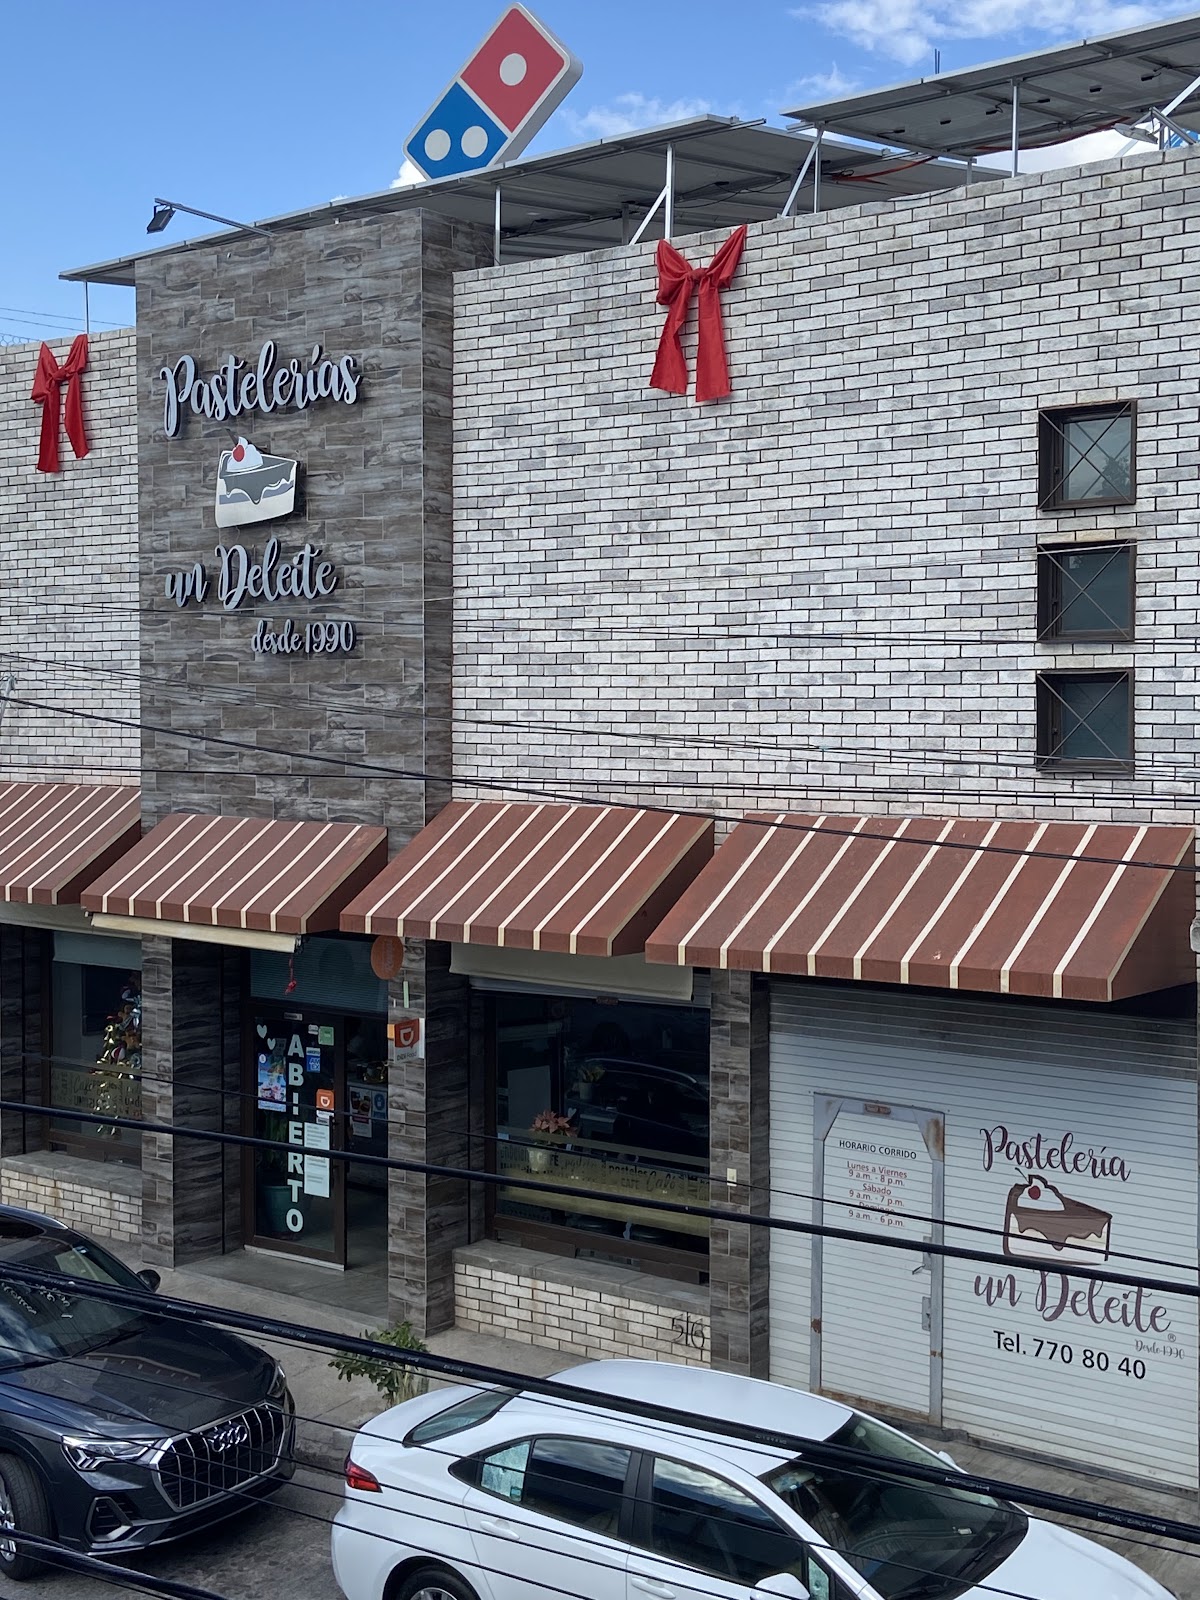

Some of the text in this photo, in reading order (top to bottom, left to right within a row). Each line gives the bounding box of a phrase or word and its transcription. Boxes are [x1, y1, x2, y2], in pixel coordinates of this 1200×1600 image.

[159, 340, 361, 437] Pastelerías
[164, 537, 338, 610] un Deleite
[250, 618, 356, 653] desde 1990
[285, 1033, 305, 1233] ABIERTO
[839, 1139, 917, 1160] HORARIO CORRIDO
[846, 1160, 870, 1172] Lunes
[878, 1166, 908, 1179] Viernes
[979, 1125, 1132, 1182] Pastelería
[848, 1169, 854, 1177] 9
[855, 1172, 873, 1181] a.m.
[880, 1174, 885, 1183] 8
[887, 1177, 905, 1186] p.m.
[862, 1182, 892, 1196] Sábado
[849, 1189, 854, 1198] 9
[856, 1192, 873, 1201] a.m.
[880, 1195, 885, 1203] 7
[887, 1198, 905, 1207] p.m.
[848, 1209, 854, 1217] 9
[855, 1212, 873, 1221] a.m.
[880, 1215, 885, 1224] 6
[887, 1218, 905, 1227] p.m.
[973, 1270, 1172, 1334] un Deleite
[670, 1311, 705, 1350] 516
[993, 1330, 1146, 1380] Tel. 770 80 40
